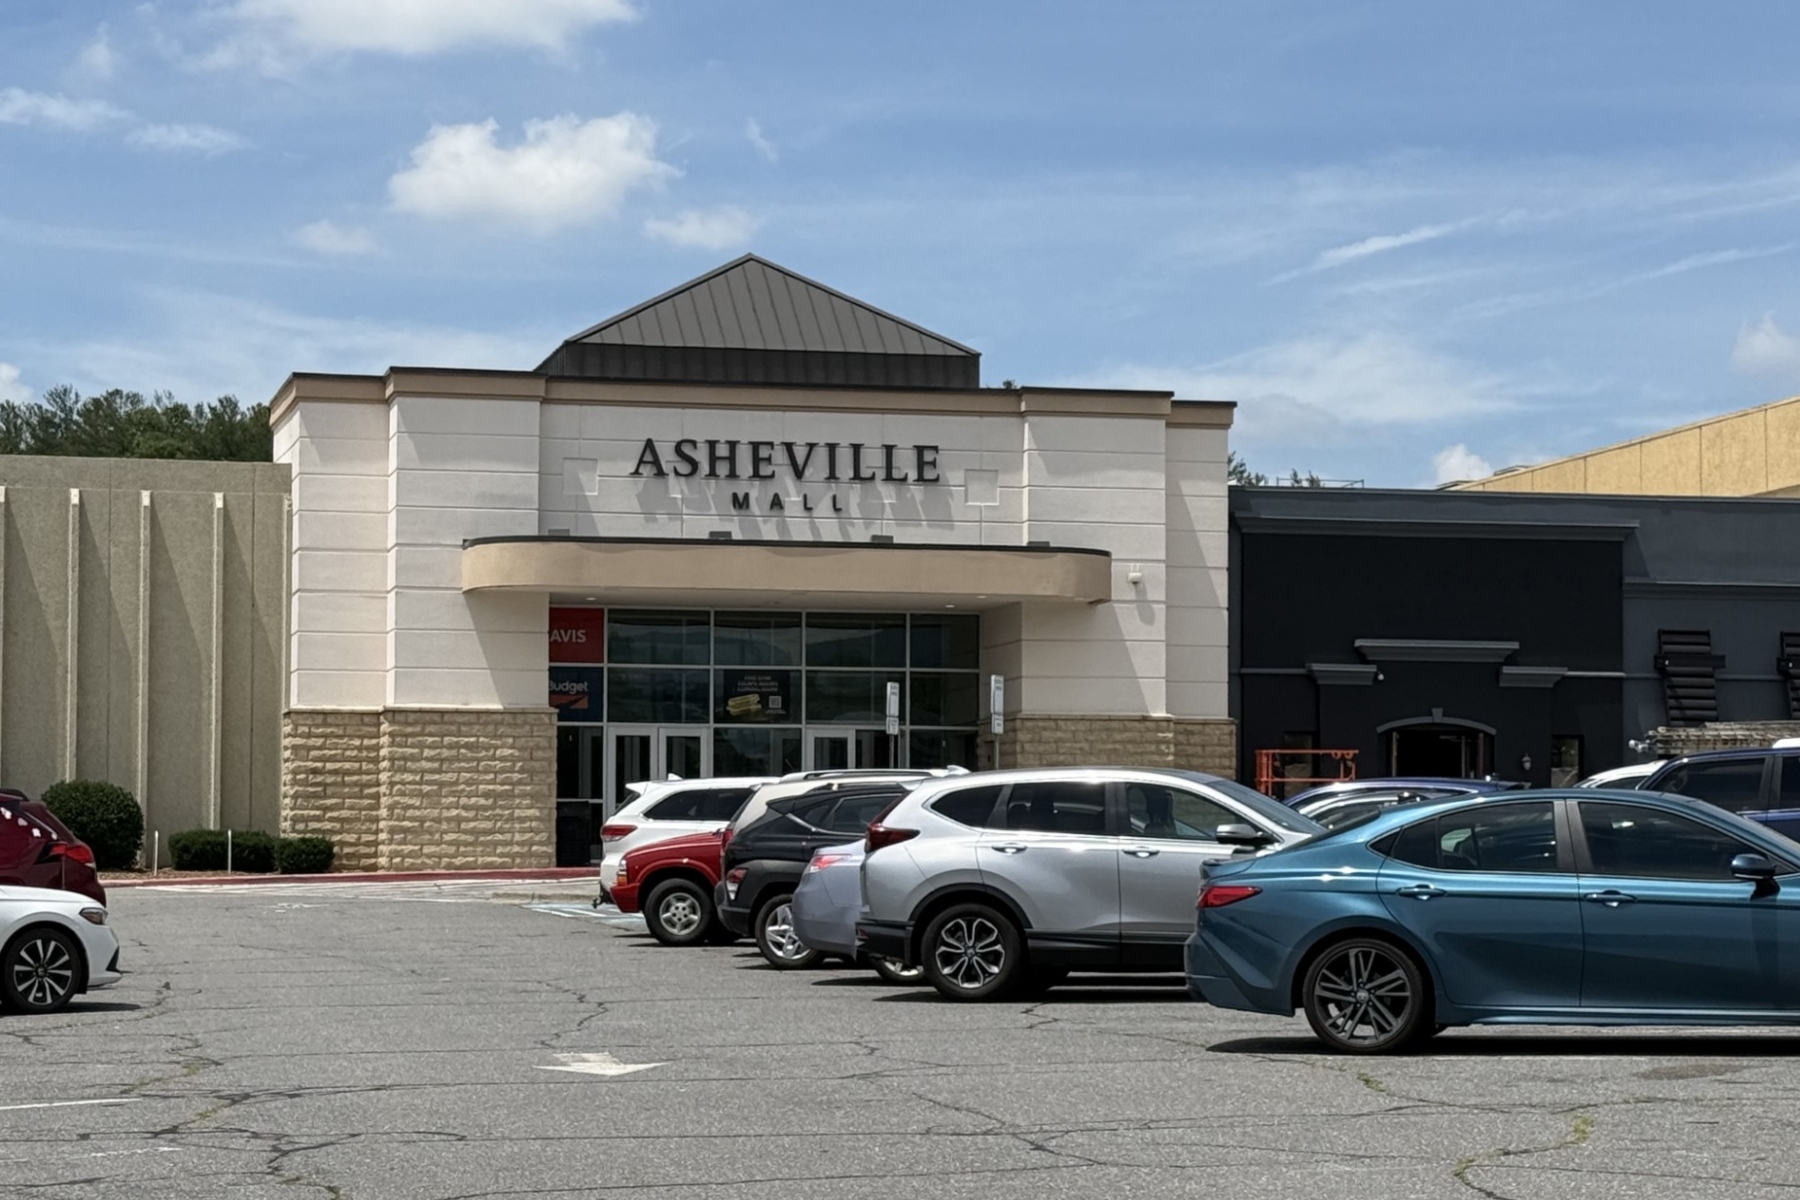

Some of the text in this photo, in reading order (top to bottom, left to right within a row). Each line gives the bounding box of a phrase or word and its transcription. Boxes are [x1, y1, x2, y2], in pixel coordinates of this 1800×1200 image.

[629, 437, 941, 483] ASHEVILLE
[731, 492, 843, 512] MALL
[549, 629, 587, 643] AVIS
